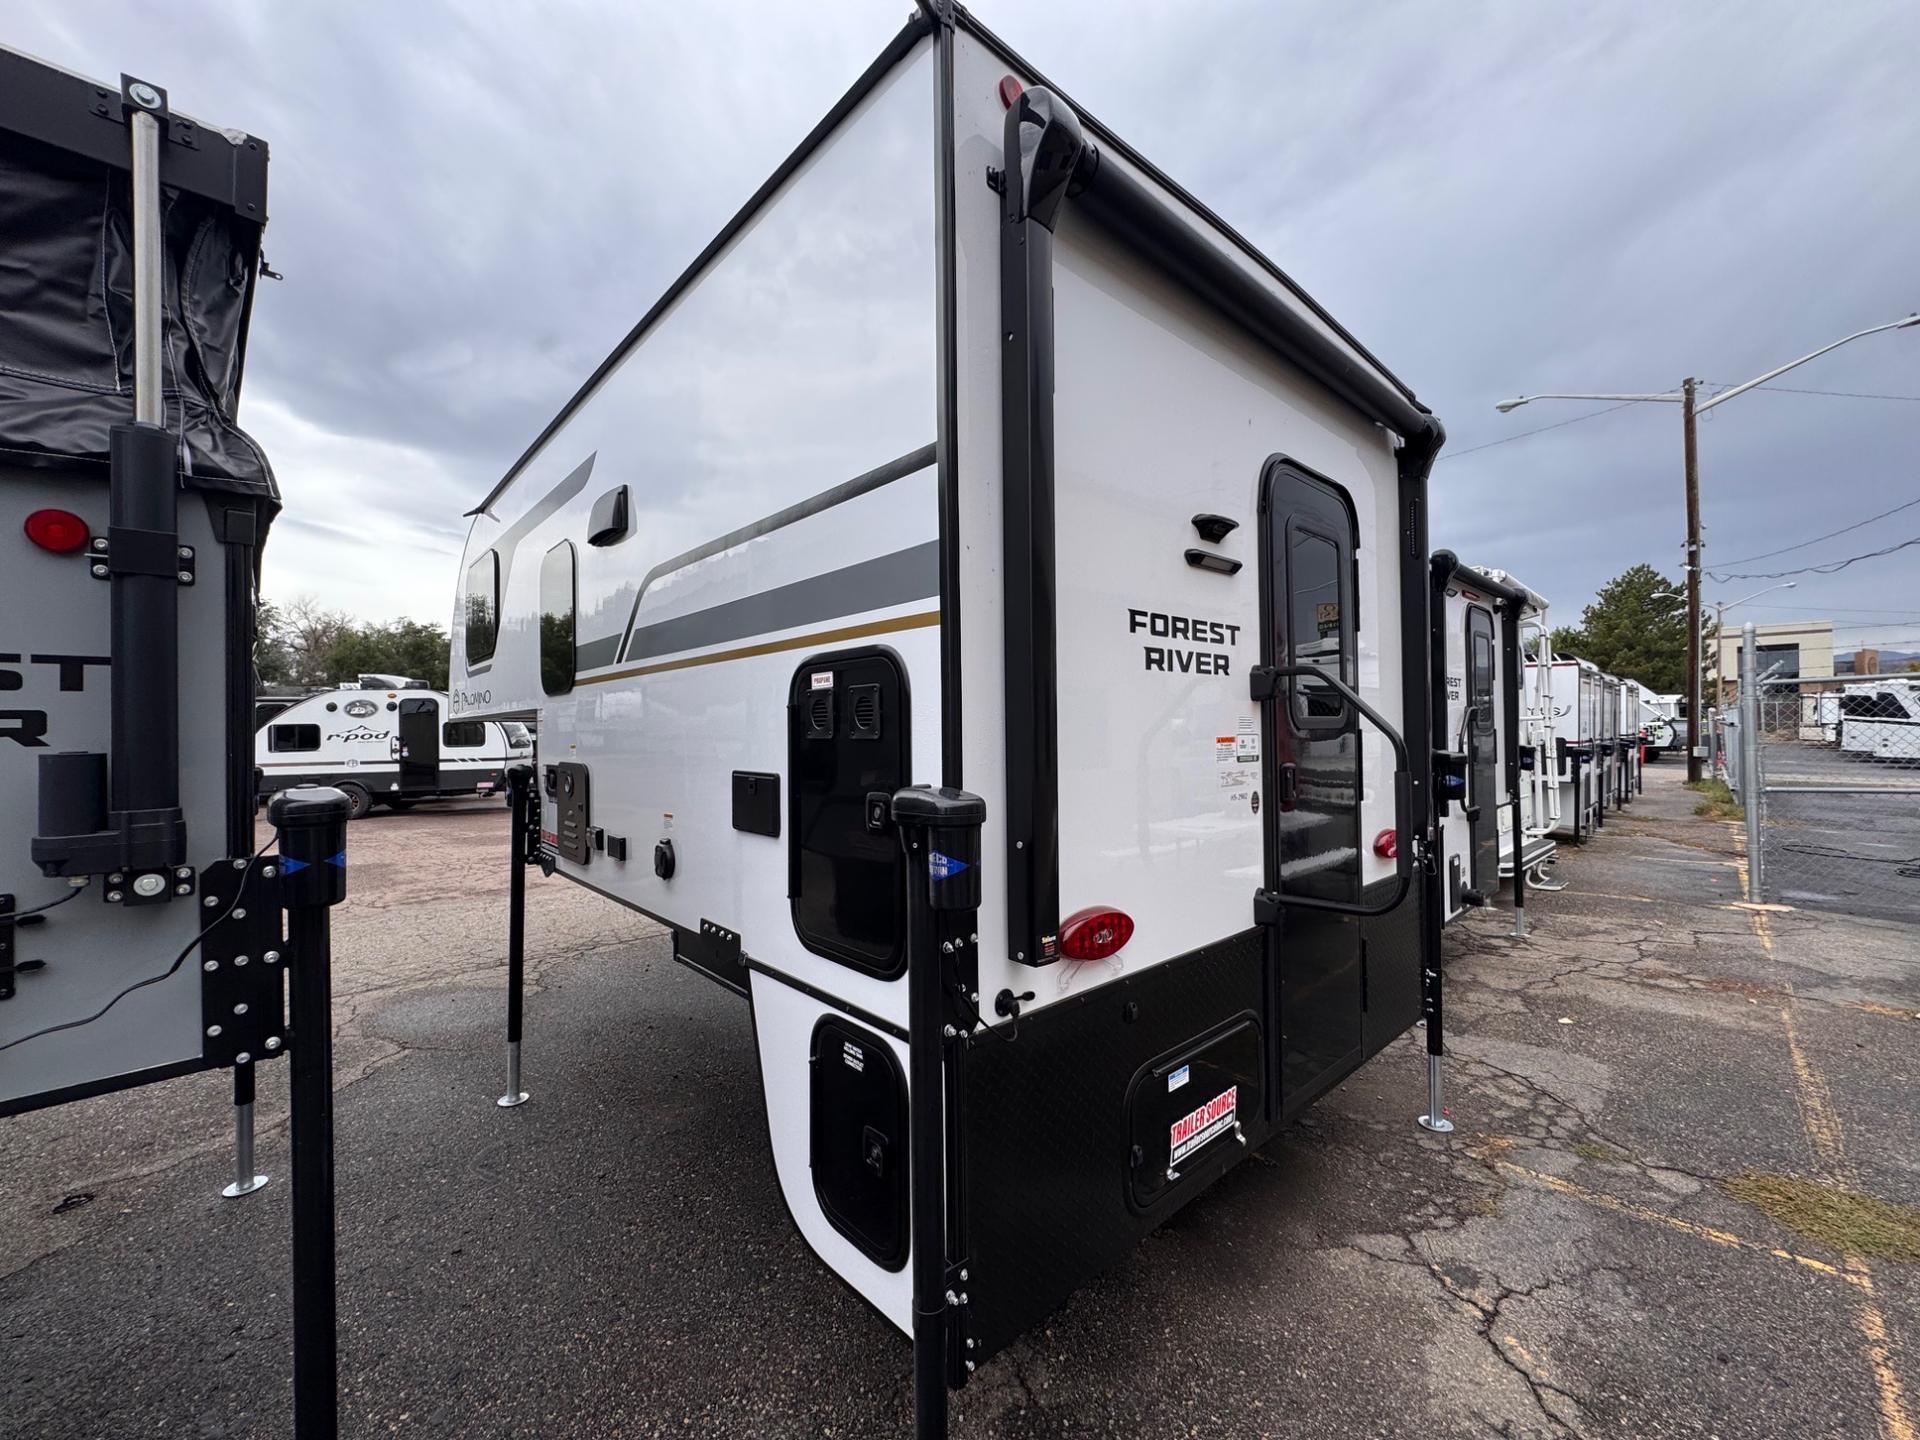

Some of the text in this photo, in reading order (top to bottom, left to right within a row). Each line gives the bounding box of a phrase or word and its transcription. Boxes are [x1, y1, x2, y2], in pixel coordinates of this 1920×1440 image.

[1127, 608, 1241, 646] FOREST
[1143, 646, 1230, 676] RIVER
[1172, 1088, 1236, 1146] TRAILER SOURCE
